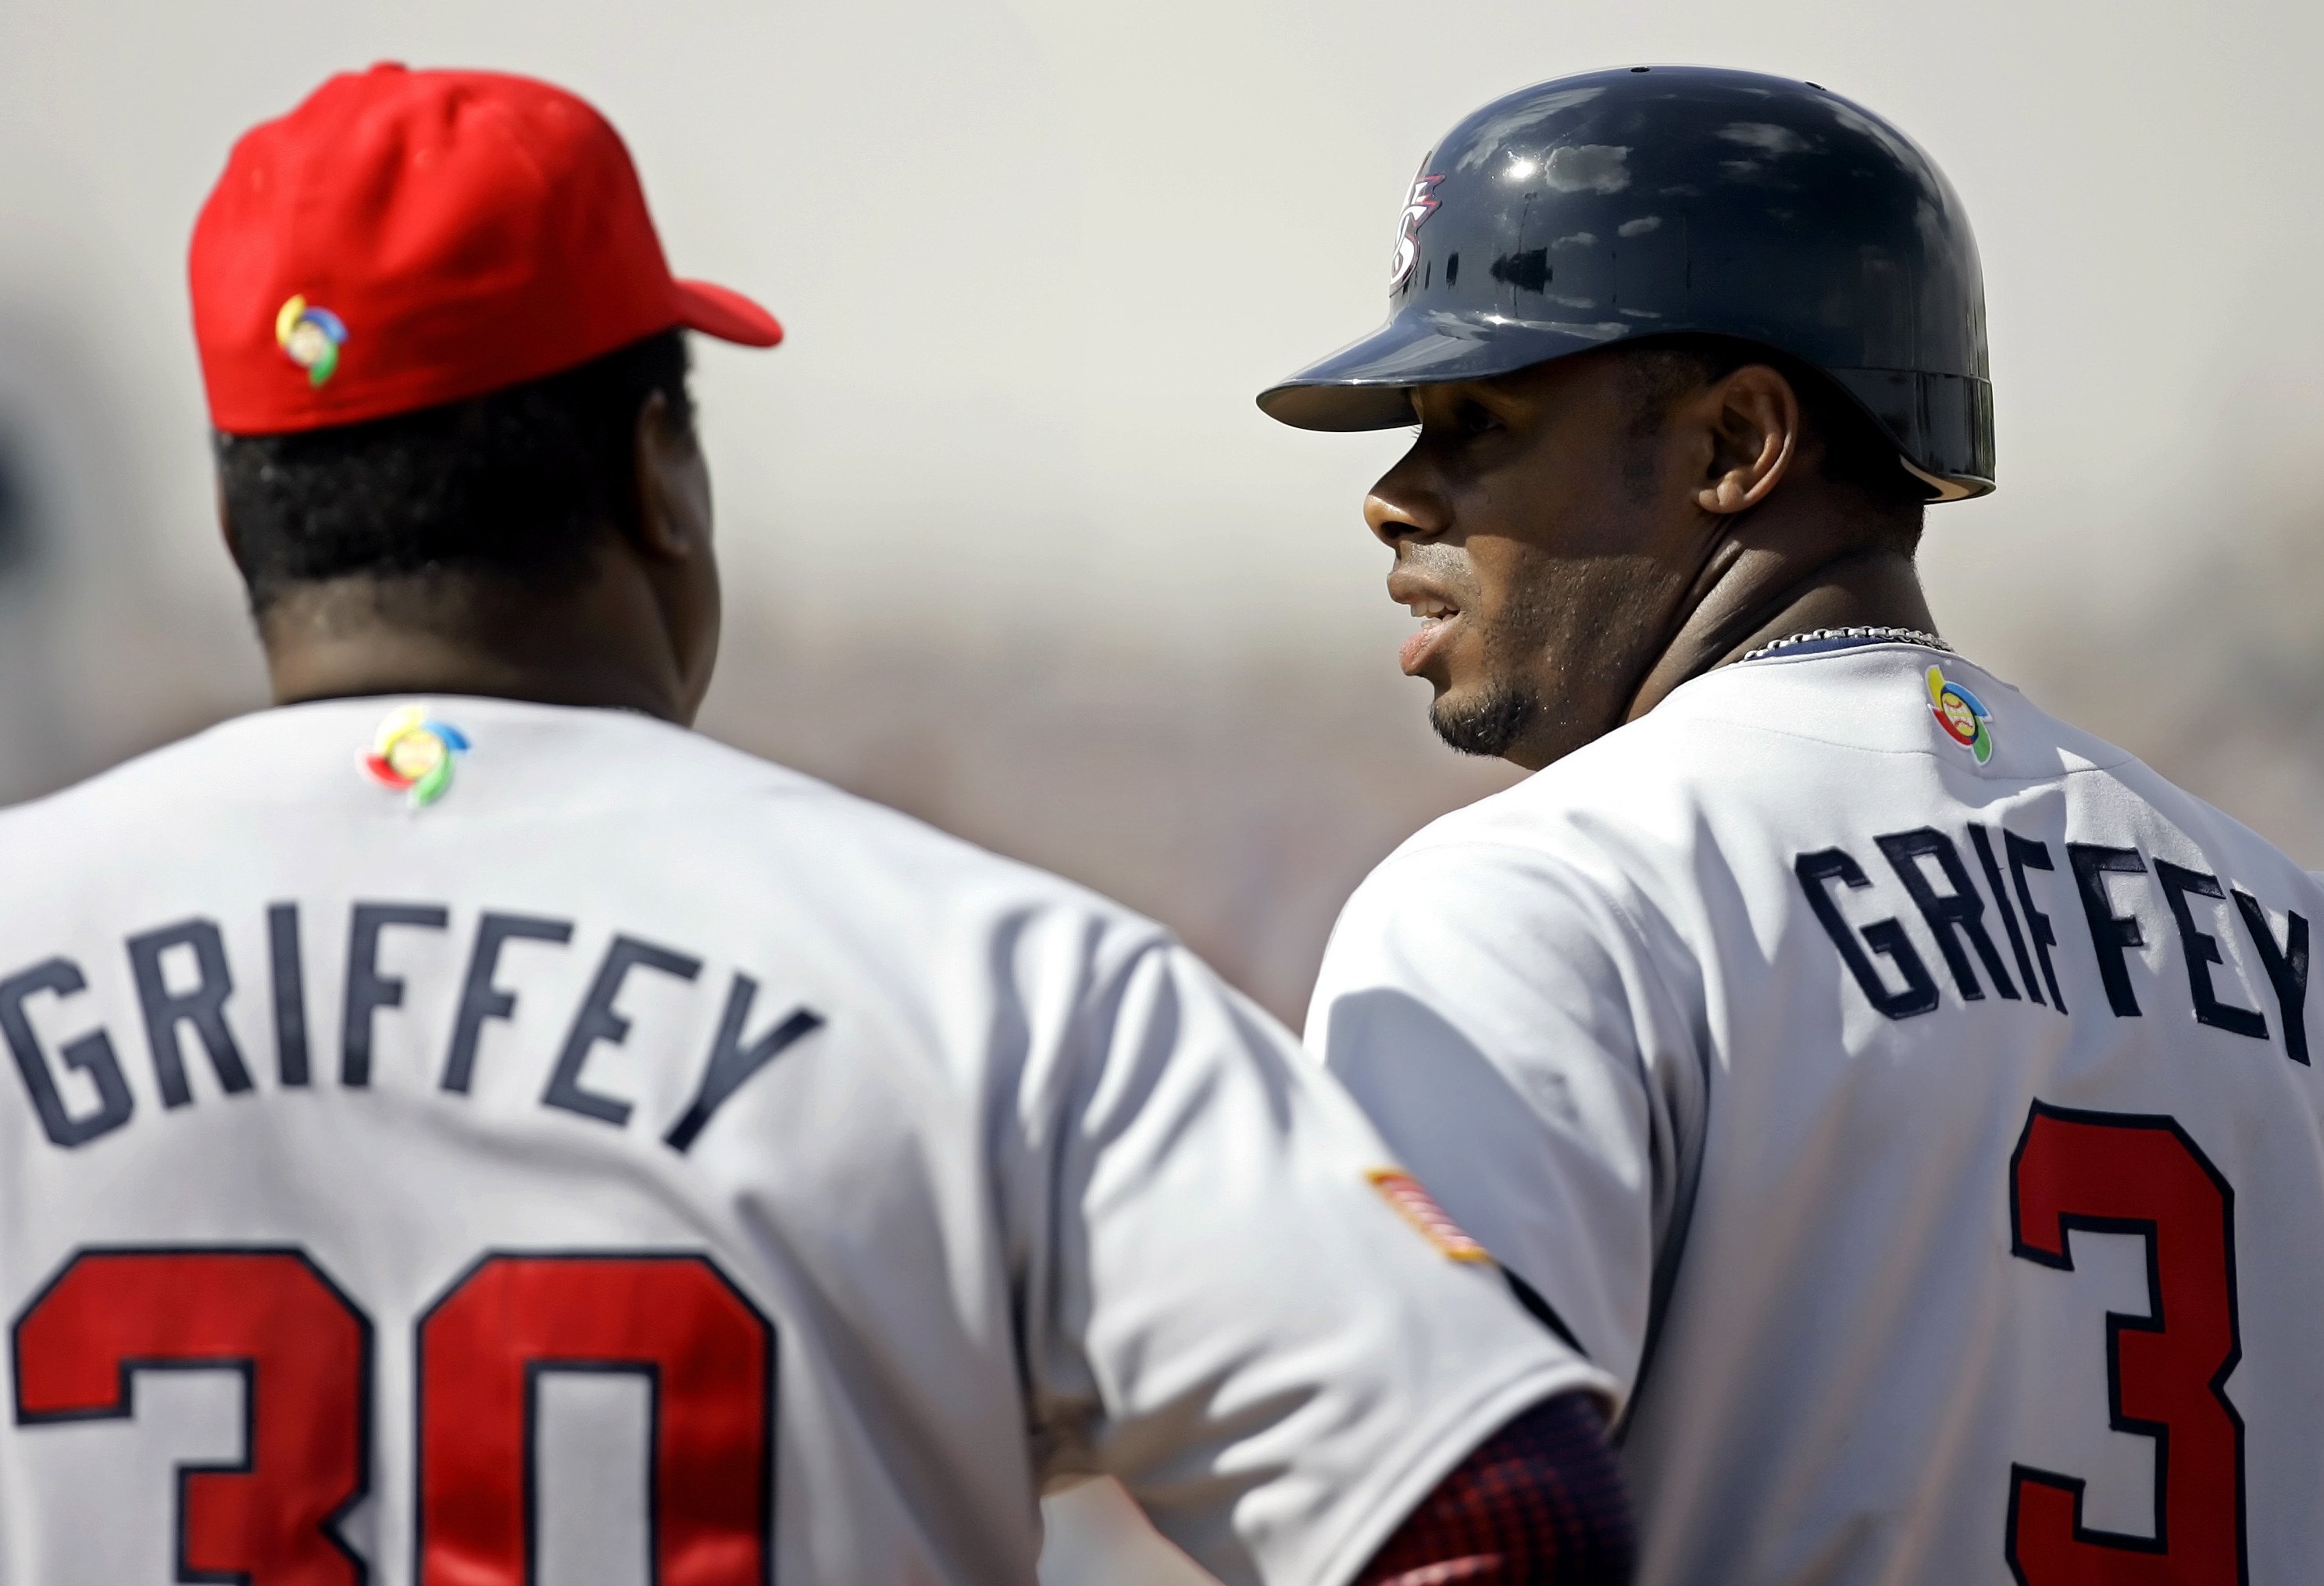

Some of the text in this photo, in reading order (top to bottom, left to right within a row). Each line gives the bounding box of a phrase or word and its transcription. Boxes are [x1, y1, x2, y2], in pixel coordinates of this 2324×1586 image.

[0, 902, 826, 1153] GRIFFEY
[1794, 821, 2311, 1066] GRIFFEY
[12, 1244, 776, 1586] 30
[2005, 1097, 2248, 1586] 3
